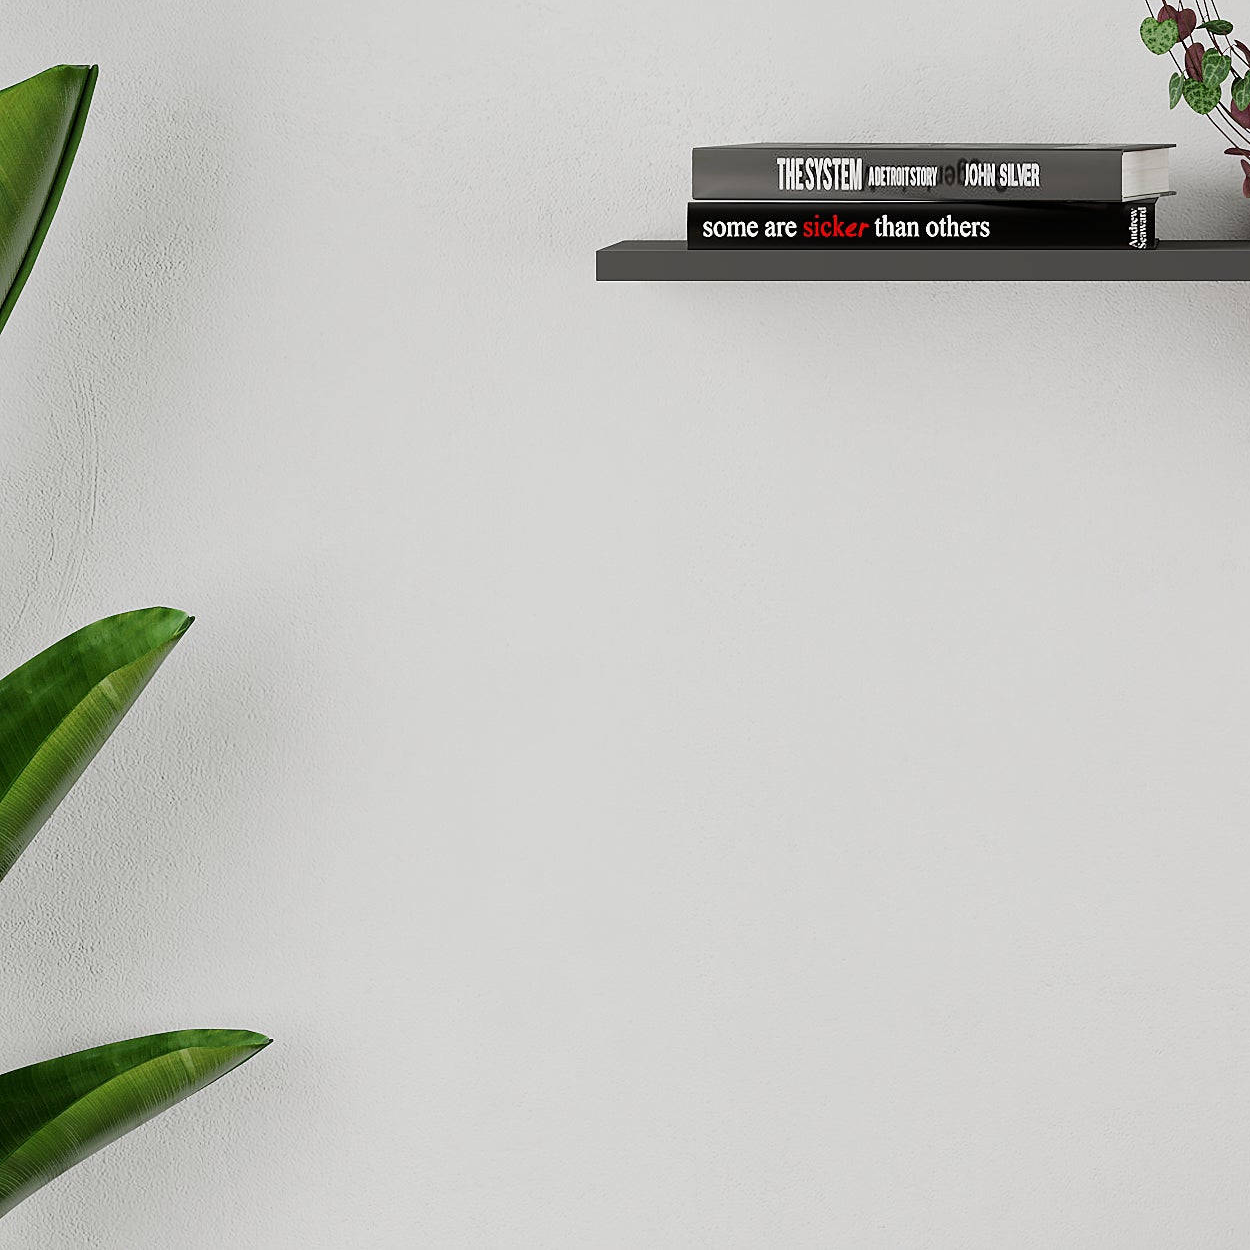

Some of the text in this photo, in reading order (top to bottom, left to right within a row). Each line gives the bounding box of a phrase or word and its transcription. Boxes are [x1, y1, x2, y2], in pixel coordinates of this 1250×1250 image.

[776, 157, 863, 191] THE SYSTEM
[964, 163, 995, 187] JOHN
[999, 163, 1040, 187] SILVER
[702, 214, 991, 238] some are sicker than others
[1128, 207, 1138, 248] Andrew
[1138, 206, 1147, 249] Seaward
